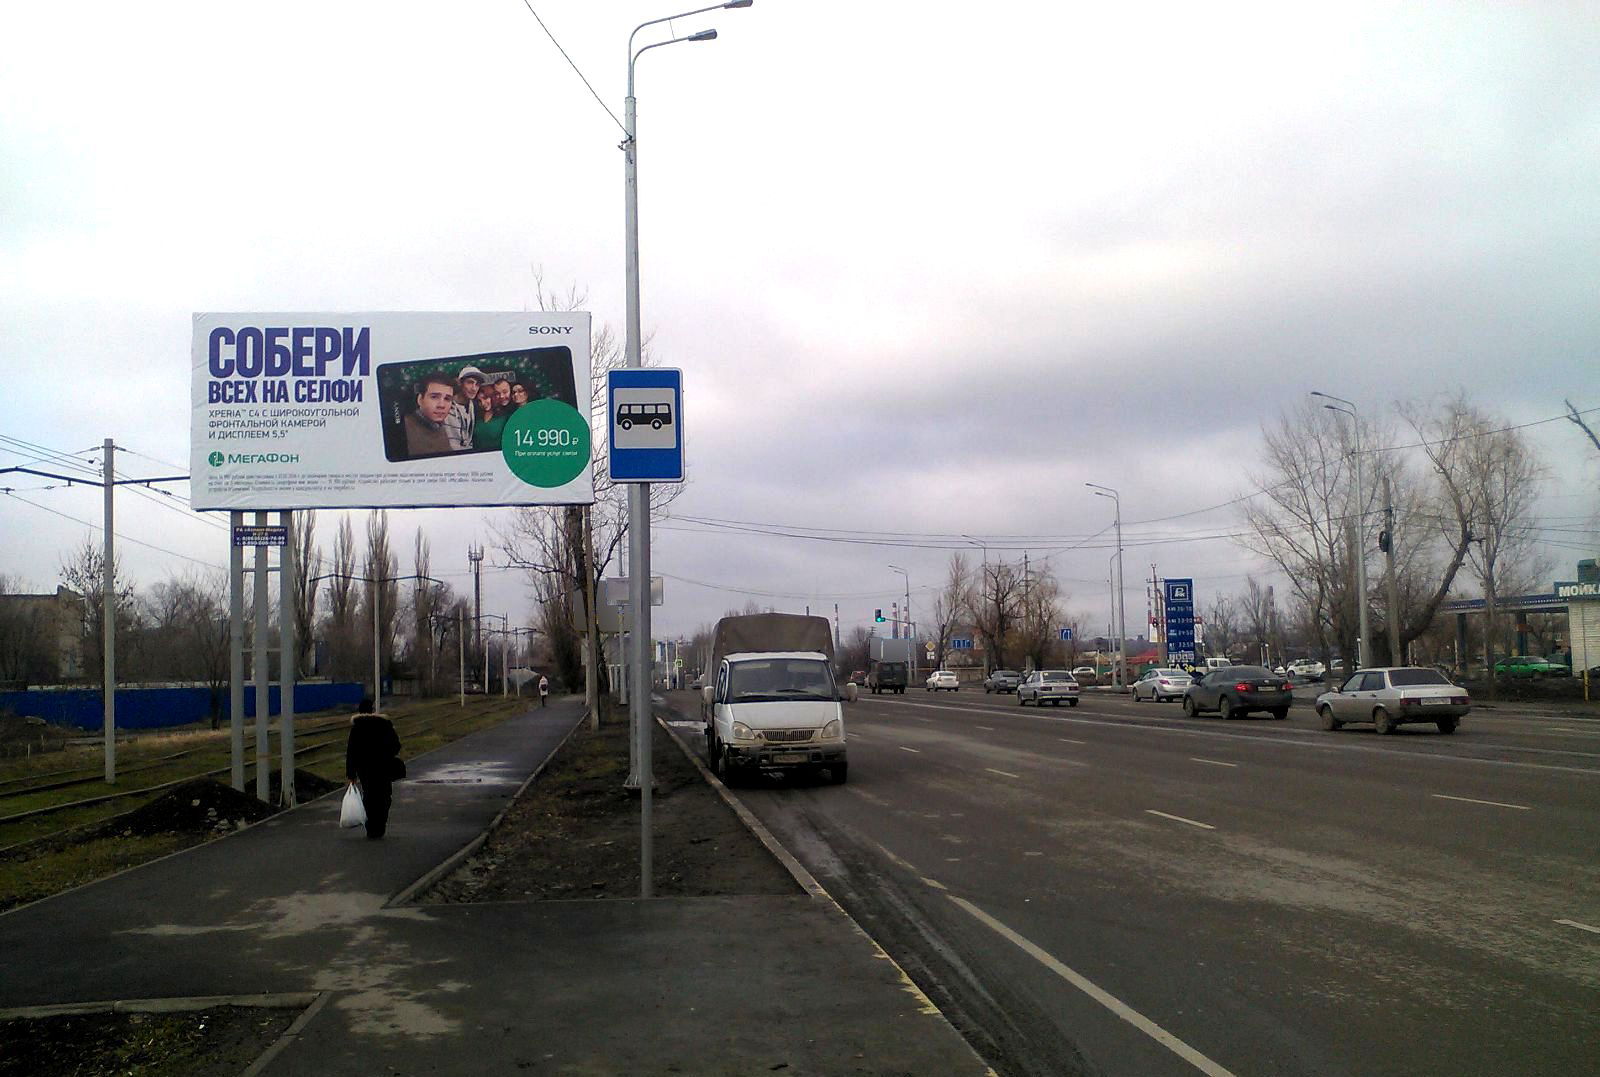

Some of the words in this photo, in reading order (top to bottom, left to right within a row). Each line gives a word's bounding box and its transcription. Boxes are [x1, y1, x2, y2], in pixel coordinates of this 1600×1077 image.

[529, 326, 573, 334] SONY
[208, 326, 370, 378] СОБЕРИ
[208, 380, 257, 404] ВСЕХ
[262, 380, 289, 403] НА
[294, 379, 363, 403] СЕЛФИ
[248, 409, 260, 418] C4
[270, 407, 360, 417] ШИРОКОУГОЛЬНОЙ
[208, 419, 279, 428] ФРОНТАЛЬНОЙ
[280, 418, 326, 428] КАМЕРОЙ
[208, 431, 215, 439] И
[217, 430, 270, 440] ДИСПЛЕЕМ
[514, 429, 534, 446] 14
[537, 429, 570, 446] 990
[1559, 583, 1600, 597] МОЙК
